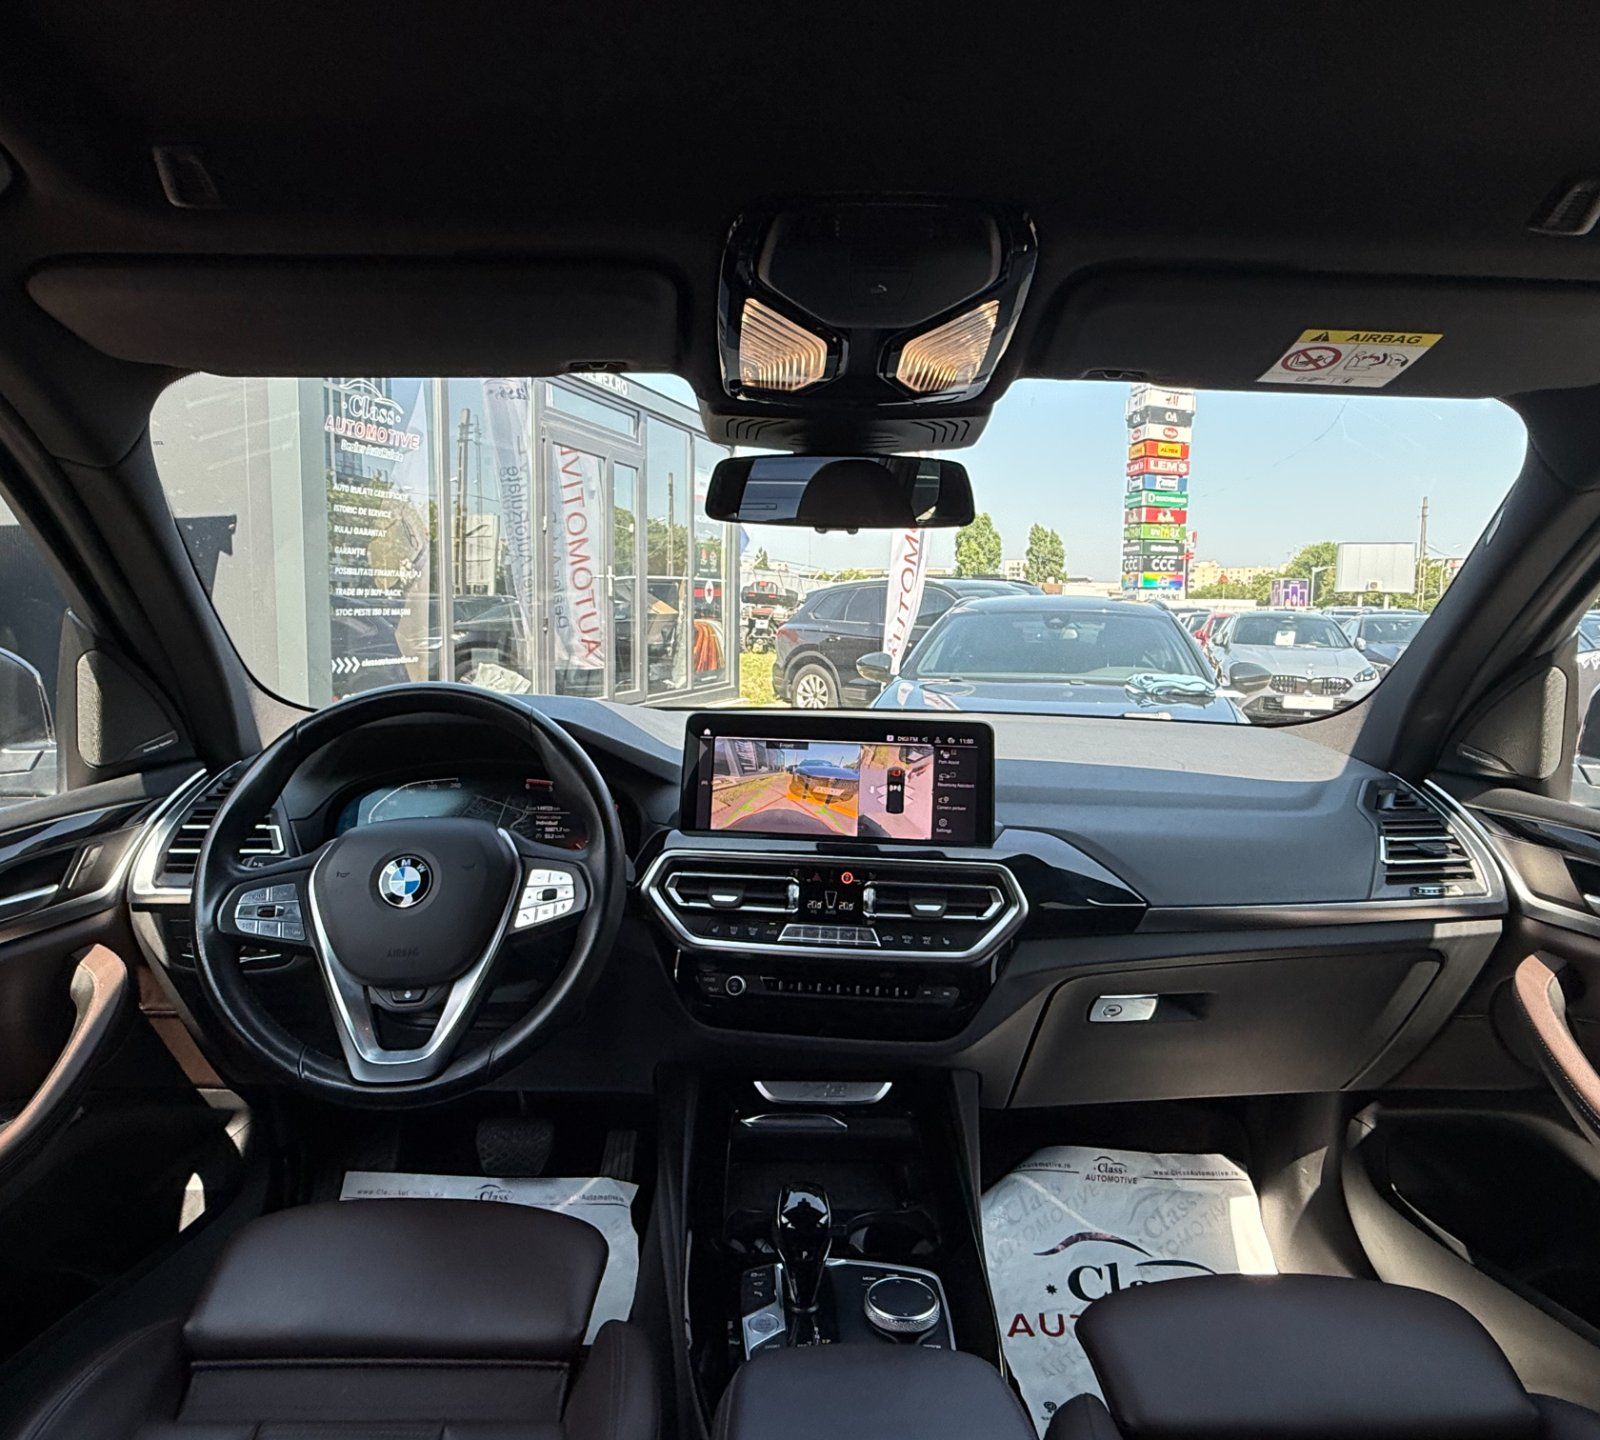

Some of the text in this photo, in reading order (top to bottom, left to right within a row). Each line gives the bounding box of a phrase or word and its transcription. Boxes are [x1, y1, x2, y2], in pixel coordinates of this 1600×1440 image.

[1346, 332, 1423, 344] AIRBAG
[348, 394, 395, 426] Class
[324, 414, 421, 450] AUTOMOTIVE
[1149, 459, 1188, 473] LEM'S
[358, 507, 367, 516] DE
[1124, 559, 1138, 571] CCC
[1151, 558, 1176, 571] CCC
[892, 527, 919, 657] AUTOM
[335, 608, 353, 617] STOC
[353, 608, 371, 617] PESTE
[1097, 1162, 1124, 1175] Class
[1085, 1173, 1138, 1185] AUTOMOTIVE
[1007, 1312, 1081, 1338] AU
